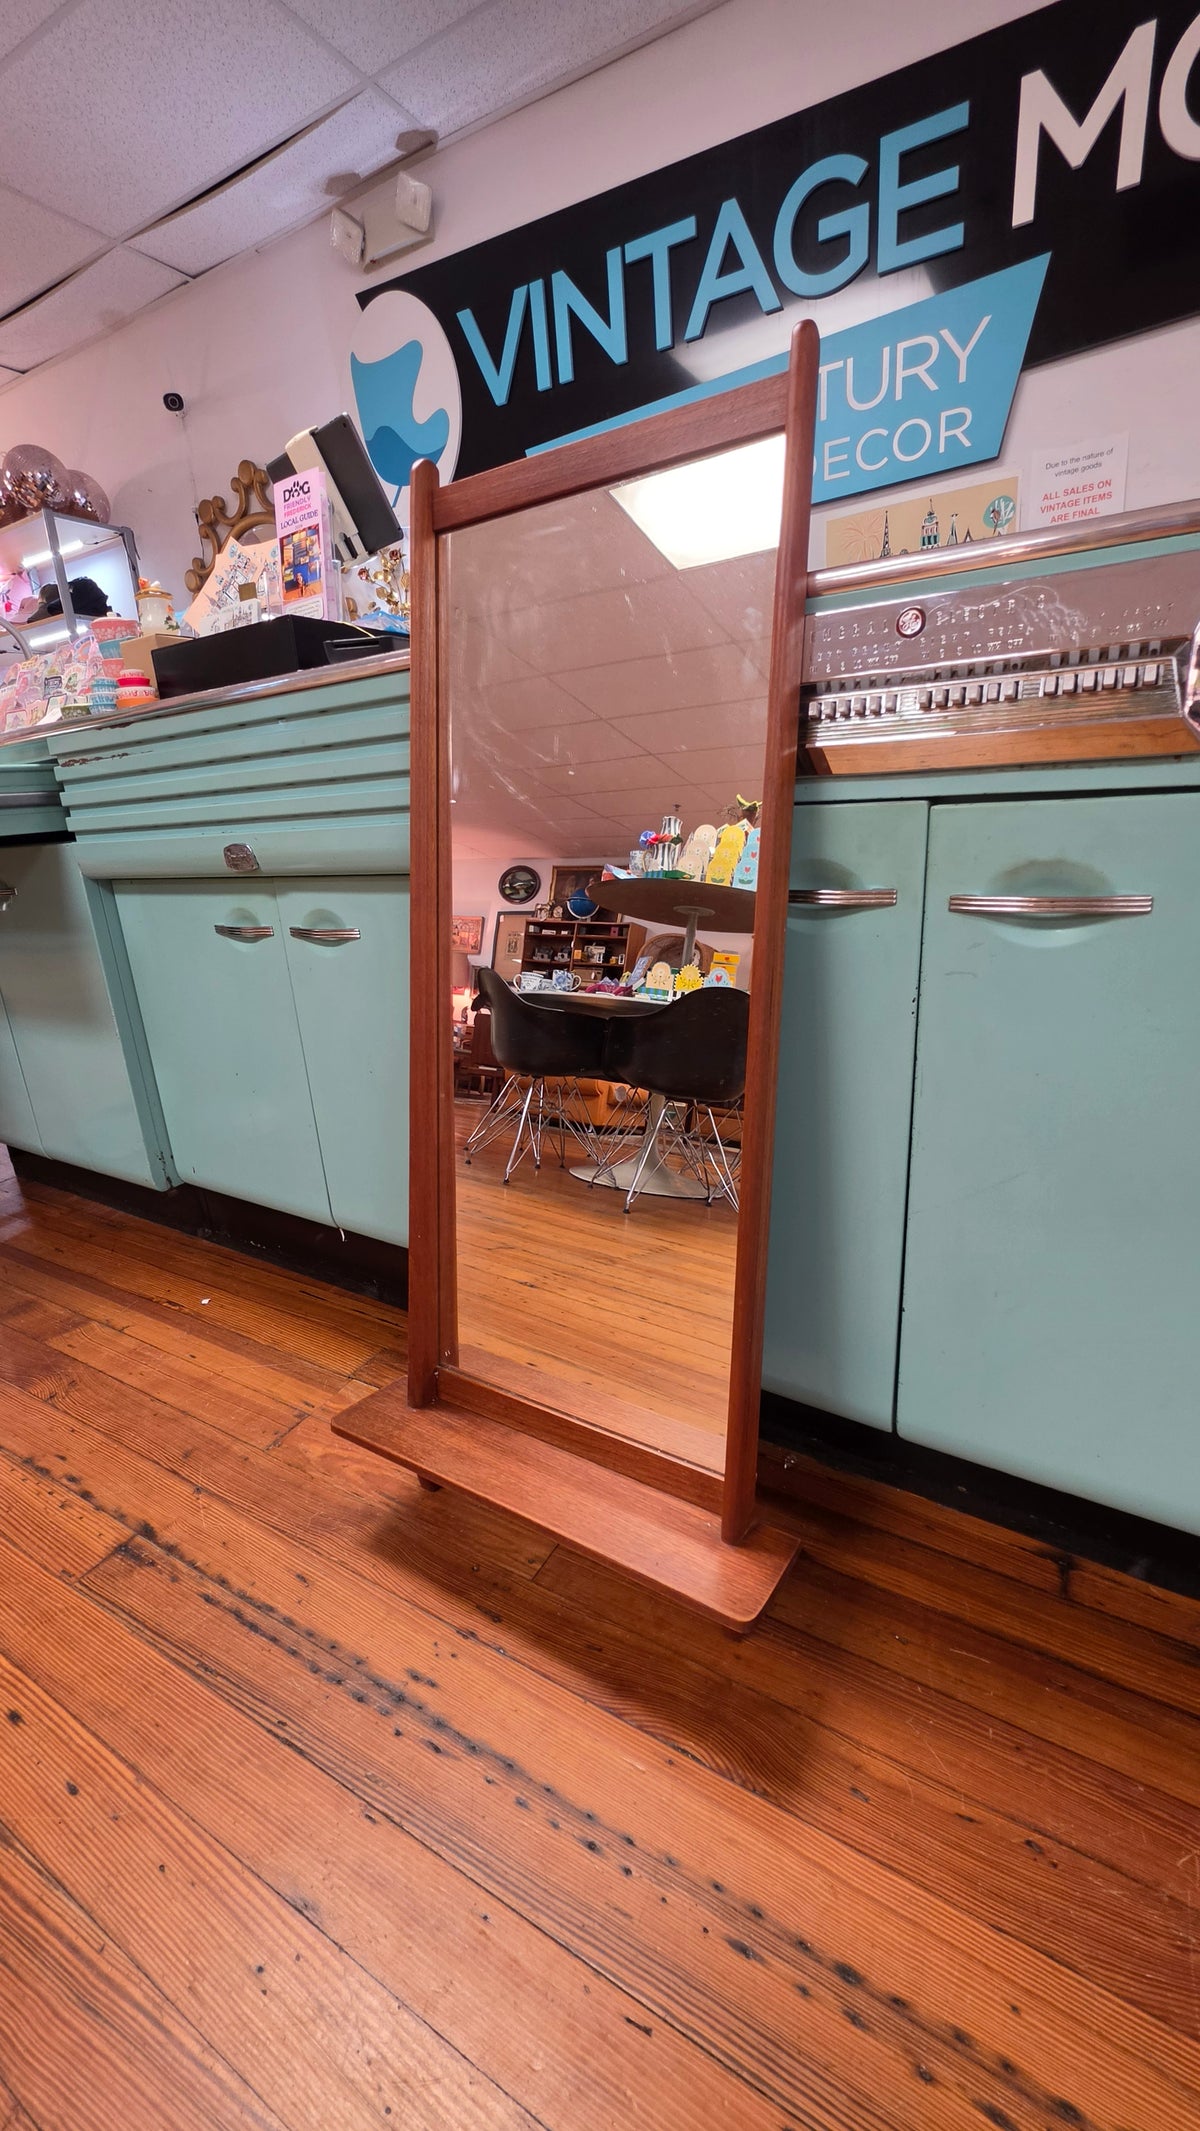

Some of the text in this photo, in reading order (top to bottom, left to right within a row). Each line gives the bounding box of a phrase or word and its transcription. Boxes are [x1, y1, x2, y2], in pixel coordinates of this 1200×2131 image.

[456, 100, 970, 407] VINTAGE
[818, 314, 992, 421] TURY
[812, 407, 973, 482] ECOR
[1045, 447, 1114, 470] Due to the nature of
[1055, 462, 1102, 477] vintage goods
[1040, 491, 1113, 514] VINTAGE ITEMS
[1042, 480, 1112, 502] ALL SALES ON
[280, 516, 299, 530] LOCAL
[299, 510, 319, 522] GUIDE
[1050, 507, 1100, 524] ARE FINAL
